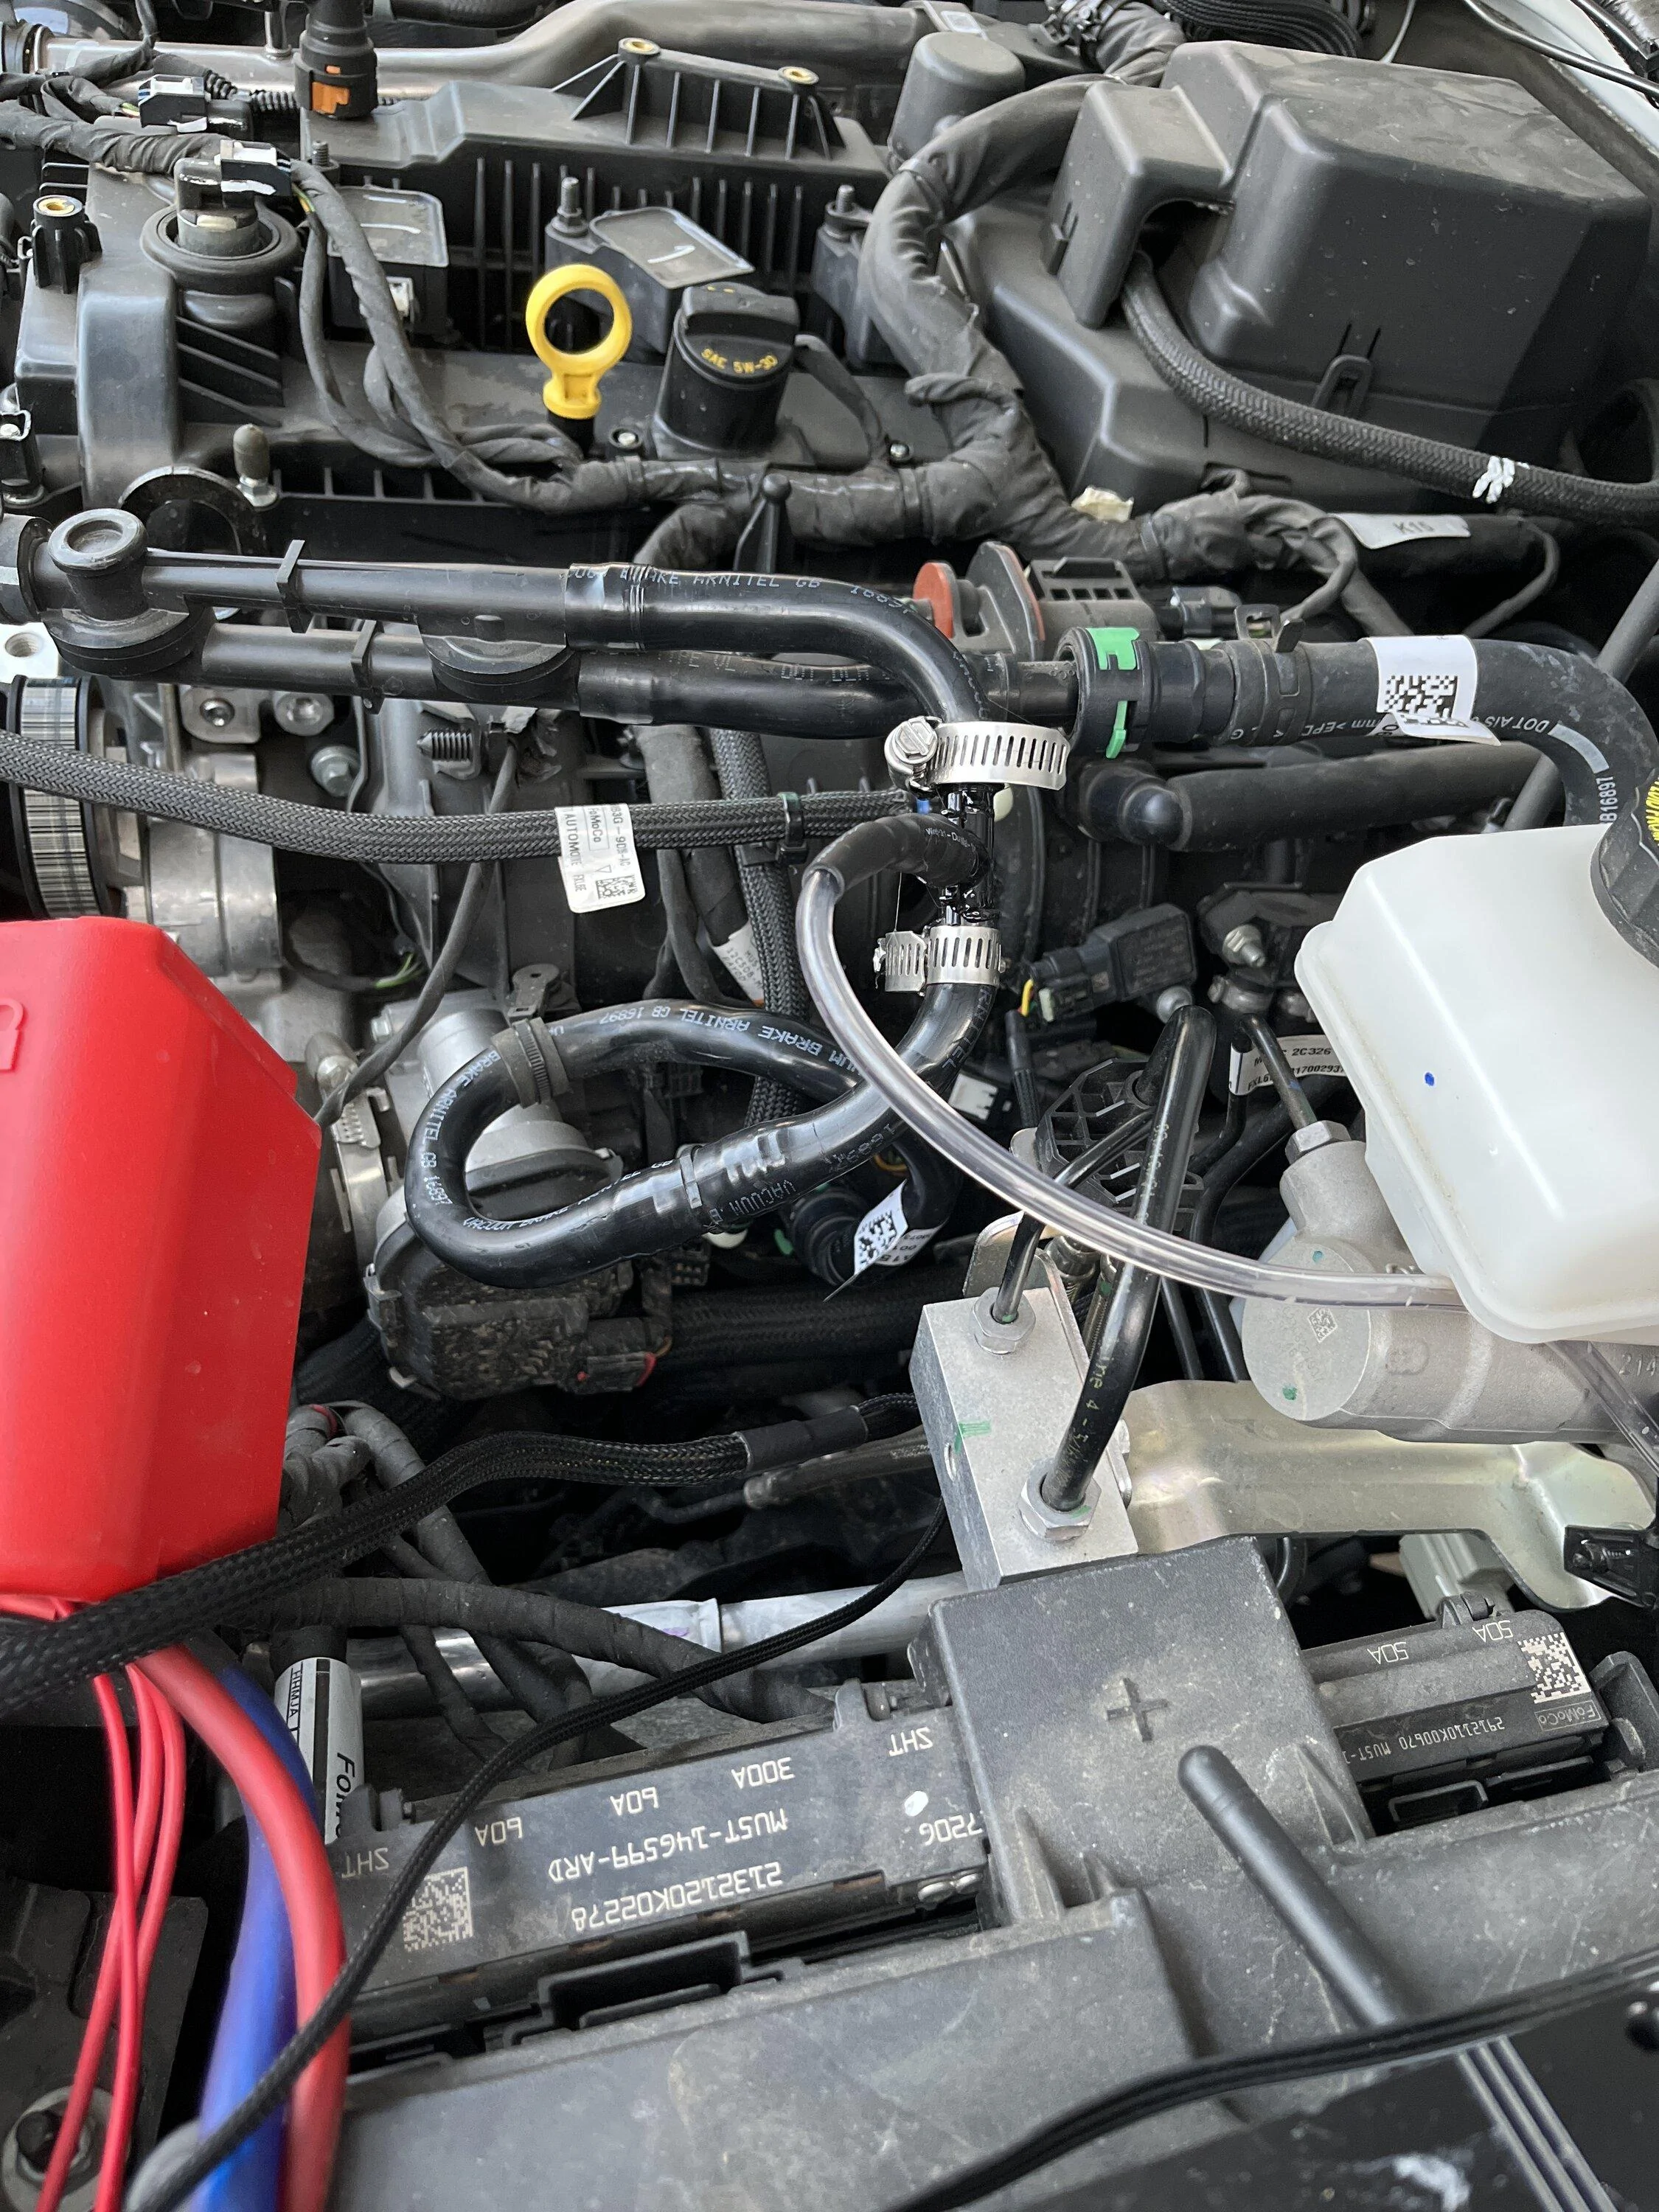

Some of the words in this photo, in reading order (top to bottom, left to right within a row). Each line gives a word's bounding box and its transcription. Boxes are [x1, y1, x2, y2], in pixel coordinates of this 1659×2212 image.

[701, 348, 728, 369] SAE
[1512, 716, 1551, 734] DOT
[680, 1008, 751, 1032] ARNITEL
[757, 1025, 824, 1057] BRAKE
[456, 1052, 501, 1087] BRAKE
[423, 1088, 459, 1141] ARNITEL
[1472, 1619, 1514, 1644] 50A
[1367, 1642, 1409, 1664] 50A
[288, 1669, 302, 1719] HHMJA
[1537, 1706, 1599, 1728] FoMoCo
[731, 1756, 796, 1789] 300A
[609, 1787, 658, 1816] 60A
[474, 1815, 523, 1848] 60A
